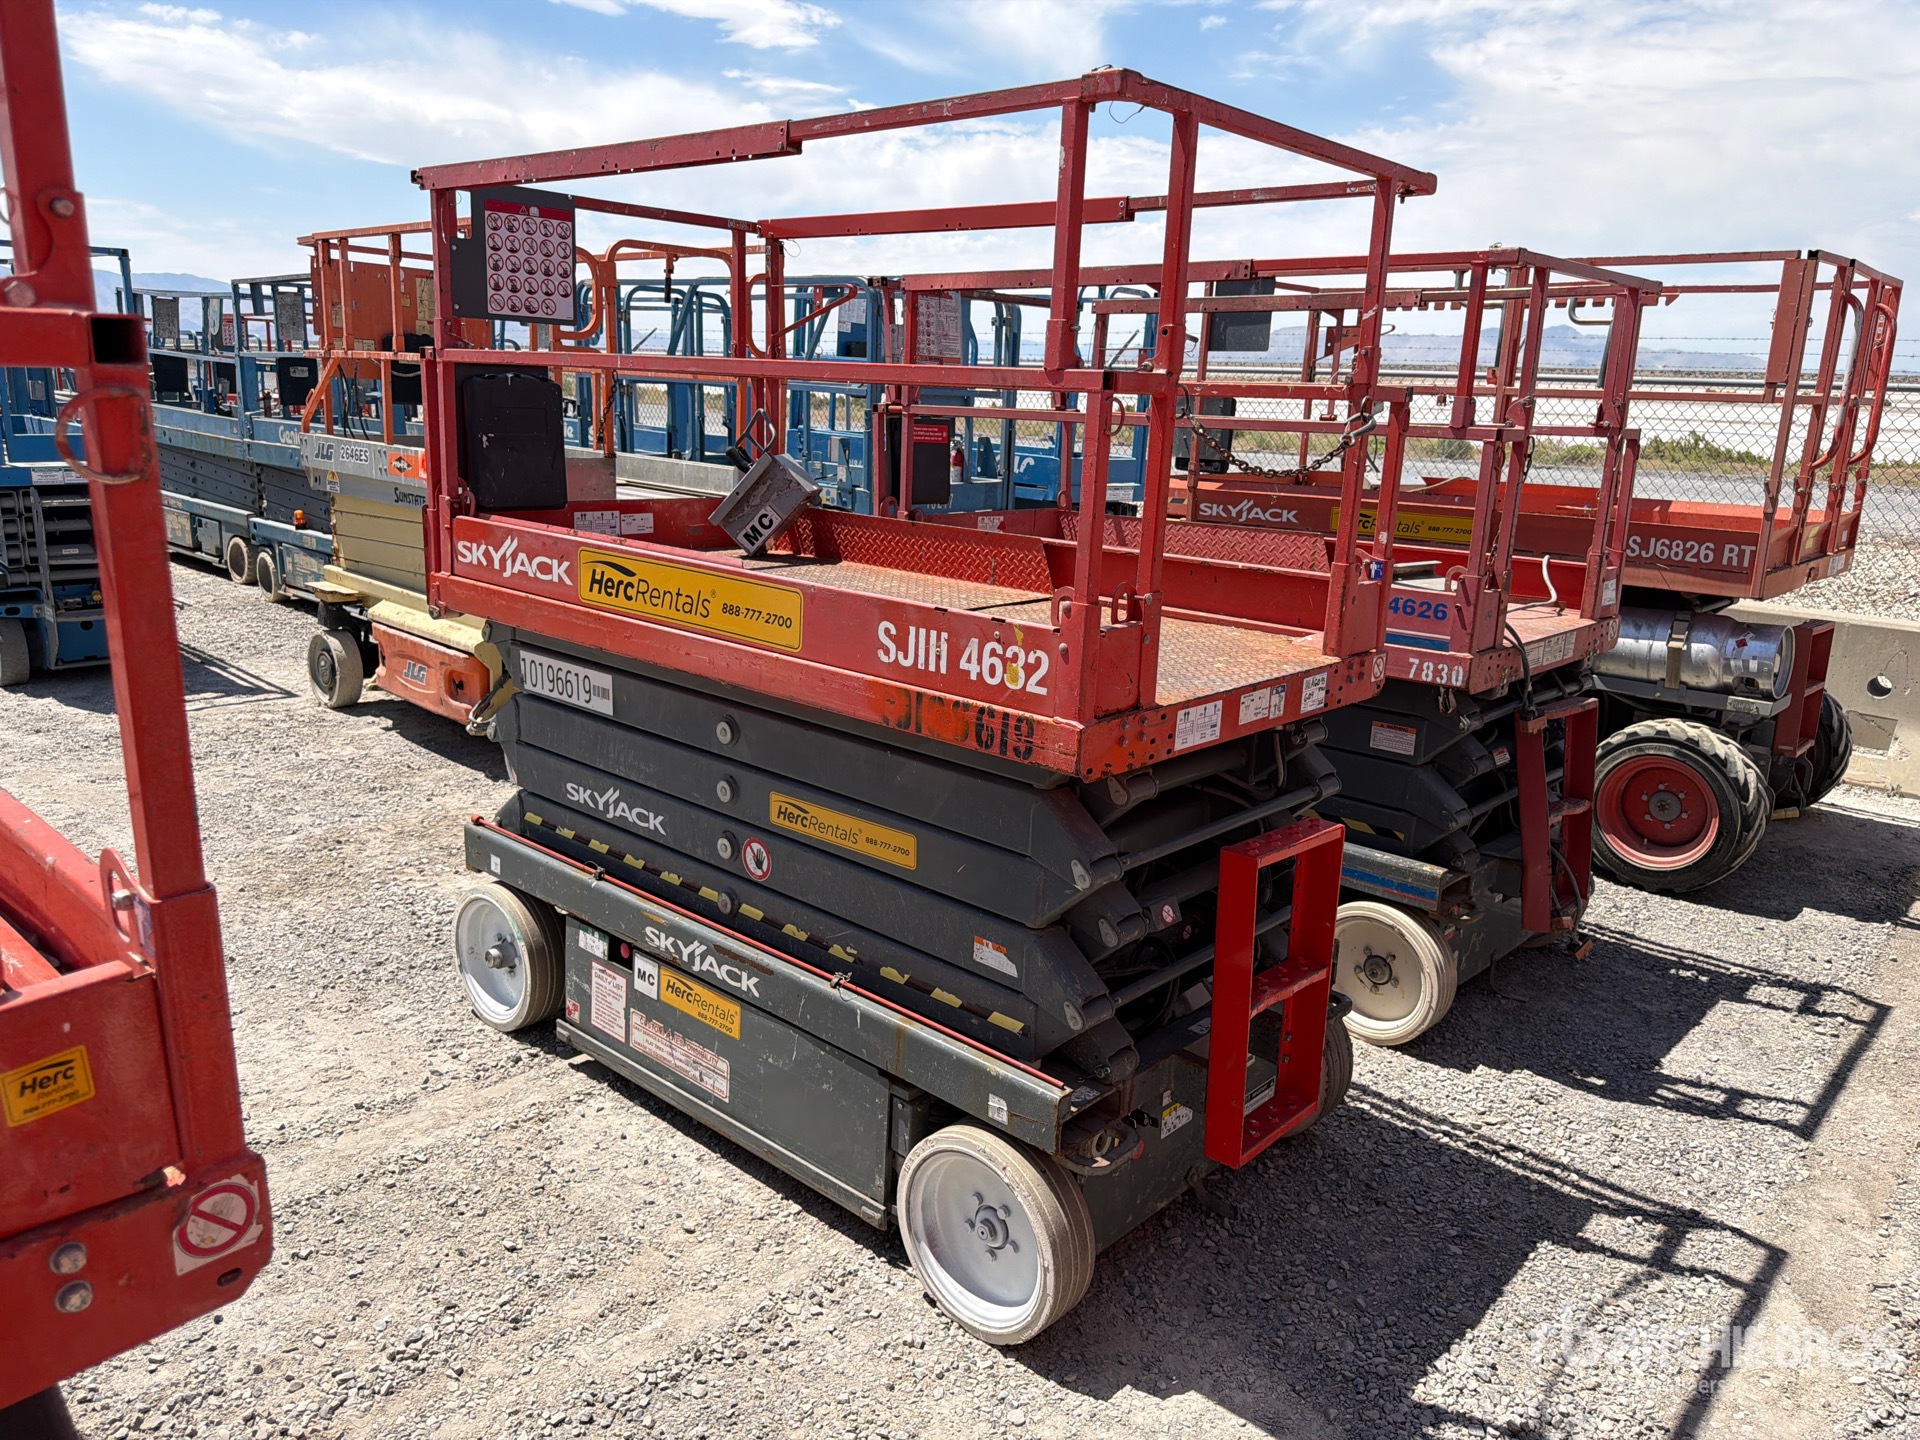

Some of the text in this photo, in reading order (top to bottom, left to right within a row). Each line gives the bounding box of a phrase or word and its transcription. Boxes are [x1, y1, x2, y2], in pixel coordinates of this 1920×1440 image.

[314, 442, 335, 462] JLG
[340, 446, 370, 465] 2646ES
[1199, 499, 1299, 524] SKYJACK
[742, 513, 774, 547] MC
[1427, 525, 1472, 536] 888-777-2700
[456, 534, 574, 586] SKYJACK
[1625, 535, 1757, 568] SJ6826 RT
[721, 602, 793, 630] 888-777-2700
[1388, 596, 1449, 621] 4626
[403, 659, 428, 685] JLG
[521, 657, 593, 704] 10196619
[959, 637, 1050, 697] 4632
[1408, 657, 1464, 687] 7830
[565, 782, 667, 836] SKYJACK
[865, 836, 911, 857] 888-777-2700
[637, 967, 655, 986] MC
[644, 926, 760, 998] SKYJACK
[697, 1011, 733, 1034] 888-777-2700
[19, 1066, 76, 1098] Herc
